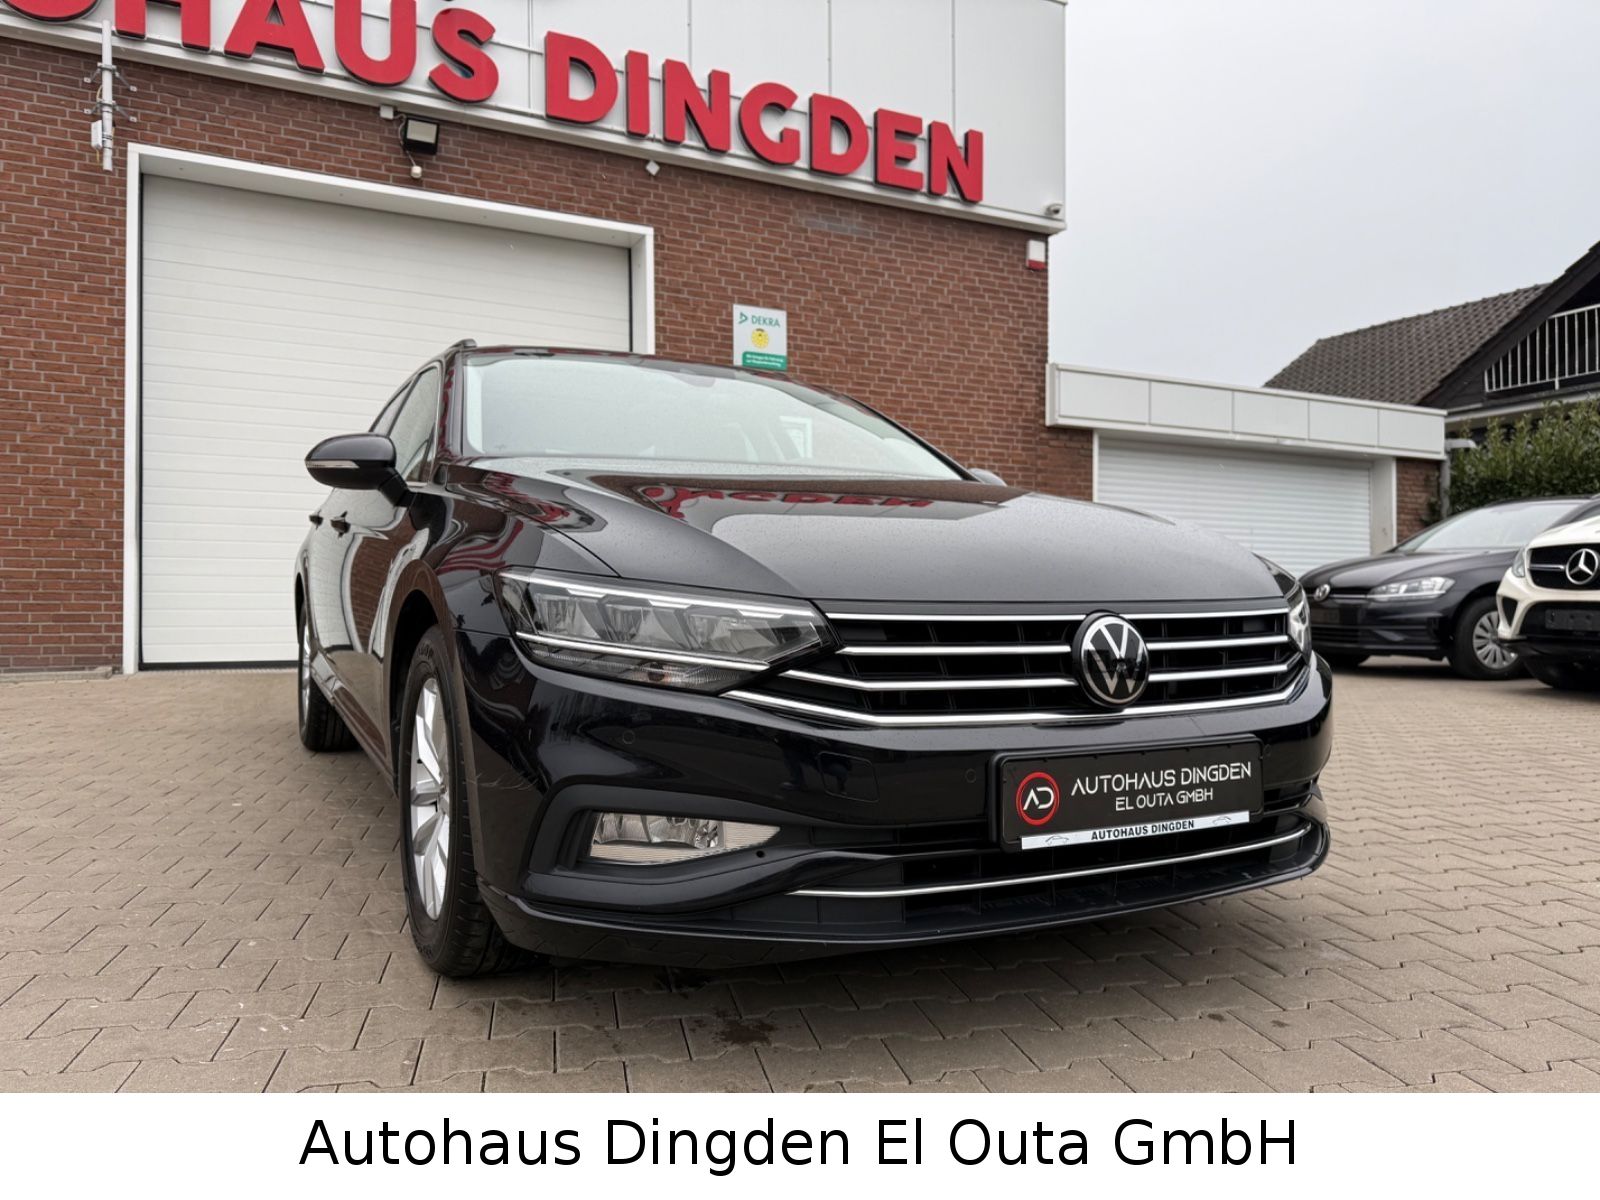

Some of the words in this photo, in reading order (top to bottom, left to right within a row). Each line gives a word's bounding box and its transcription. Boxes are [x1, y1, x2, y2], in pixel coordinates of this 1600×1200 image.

[0, 0, 500, 102] HAUS
[543, 30, 984, 203] DINGDEN
[751, 315, 781, 328] DEKRA
[1086, 621, 1146, 697] VW
[1071, 769, 1176, 797] AUTOHAUS
[1180, 761, 1252, 786] DINGDEN
[1115, 796, 1134, 811] EL
[1136, 791, 1174, 809] OUTA
[1176, 788, 1213, 804] GMBH
[1090, 823, 1149, 841] AUTOHAUS
[1151, 819, 1195, 834] DINGDEN
